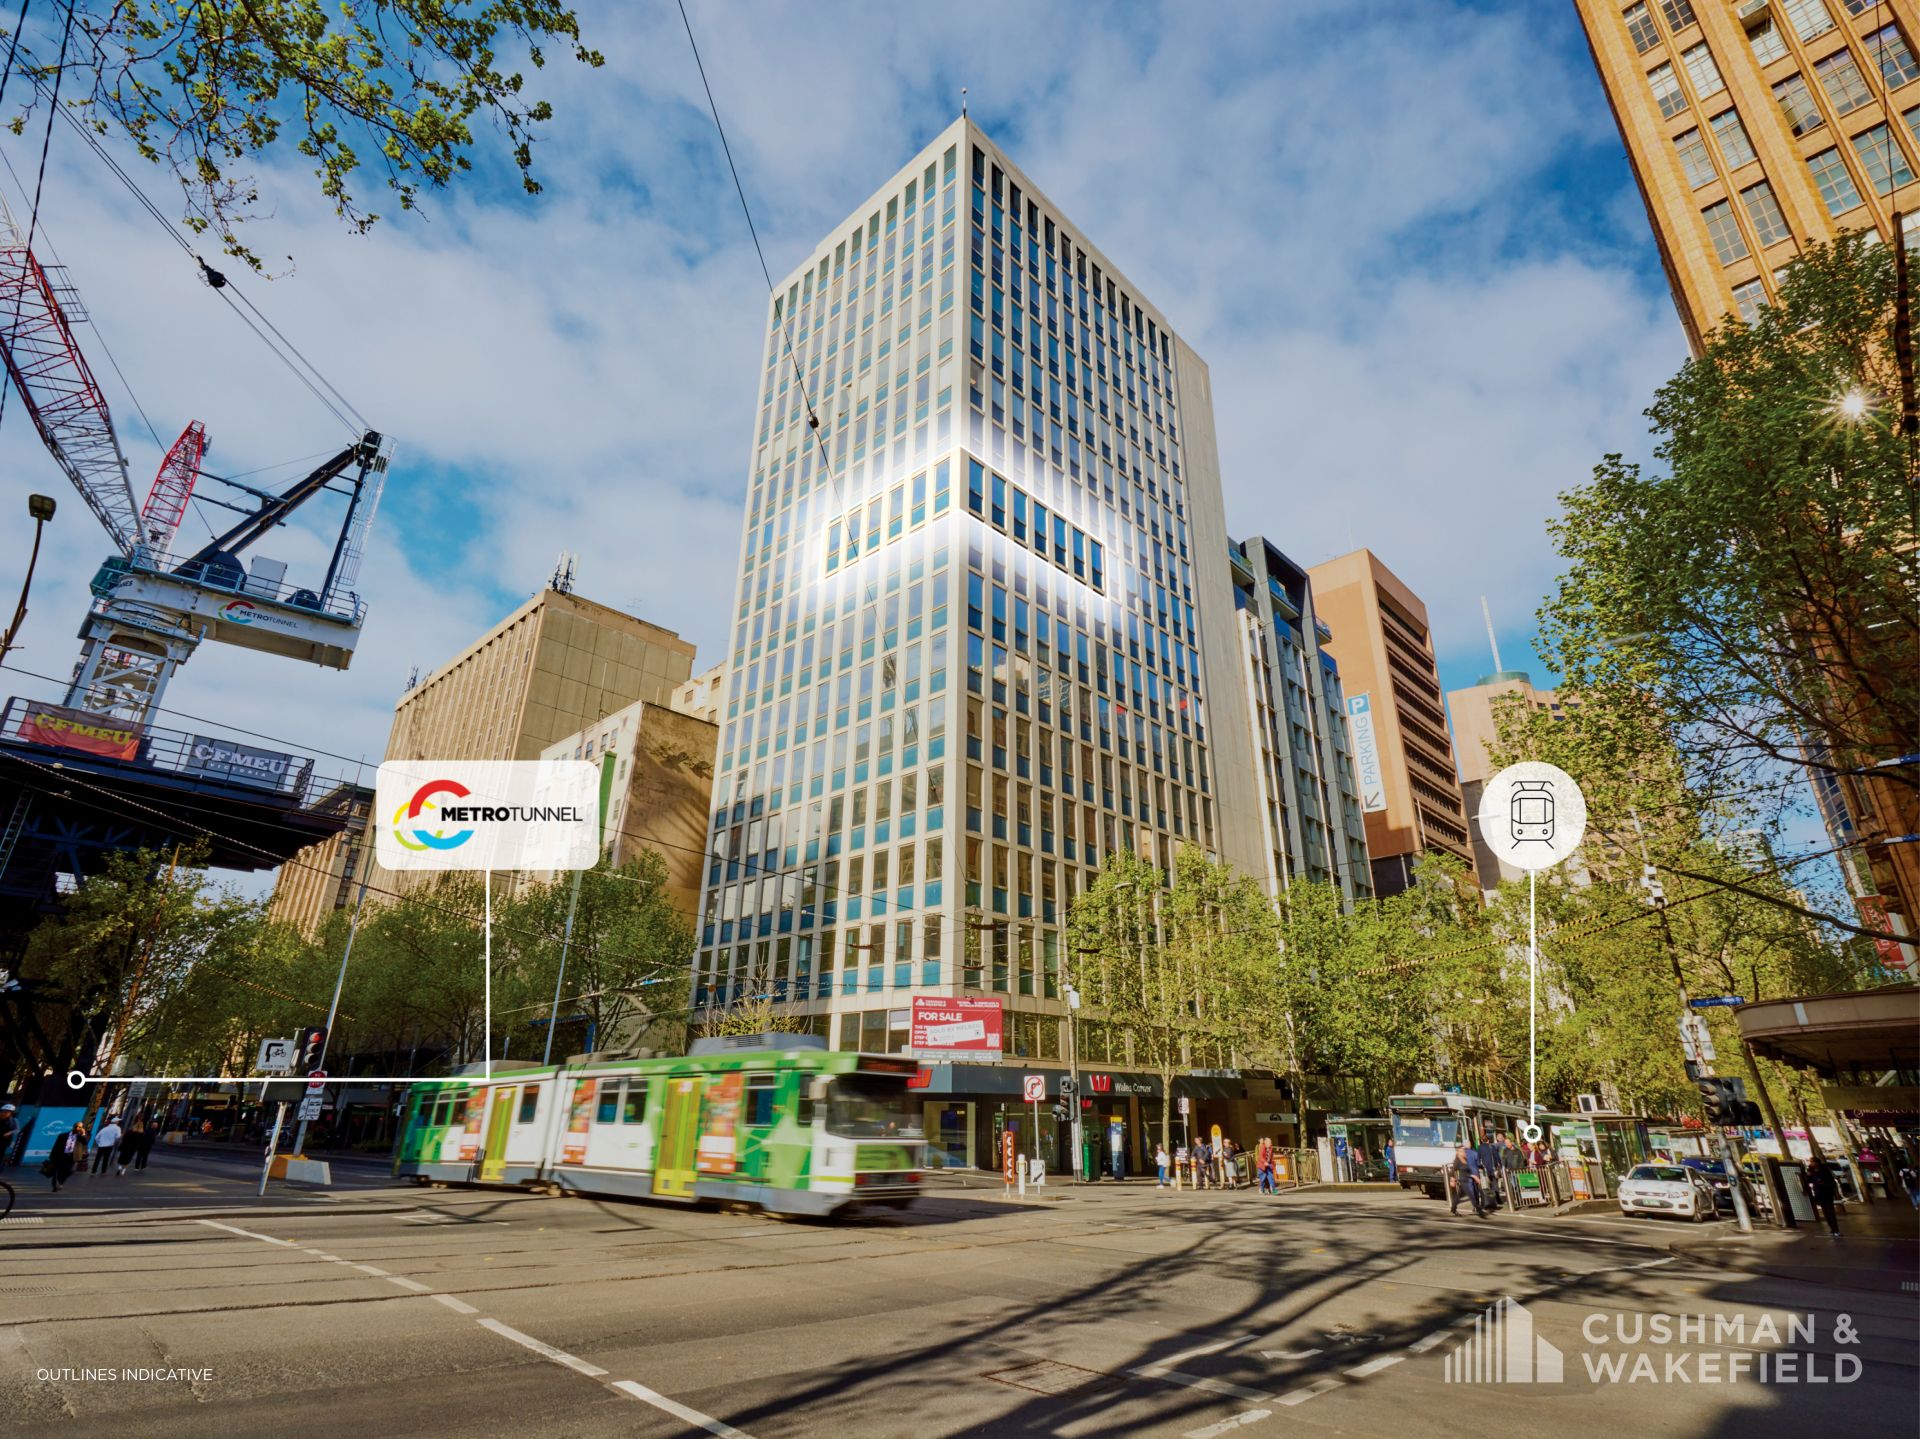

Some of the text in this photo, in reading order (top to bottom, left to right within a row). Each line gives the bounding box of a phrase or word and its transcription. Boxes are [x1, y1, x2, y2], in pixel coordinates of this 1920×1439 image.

[1351, 698, 1365, 714] P
[35, 713, 133, 745] CFMEU
[1354, 716, 1377, 785] PARKING
[195, 744, 287, 774] CFMEU
[210, 762, 266, 777] VICTORIA
[918, 1011, 963, 1022] FOR SALE
[1115, 1082, 1152, 1093] Wales Corner
